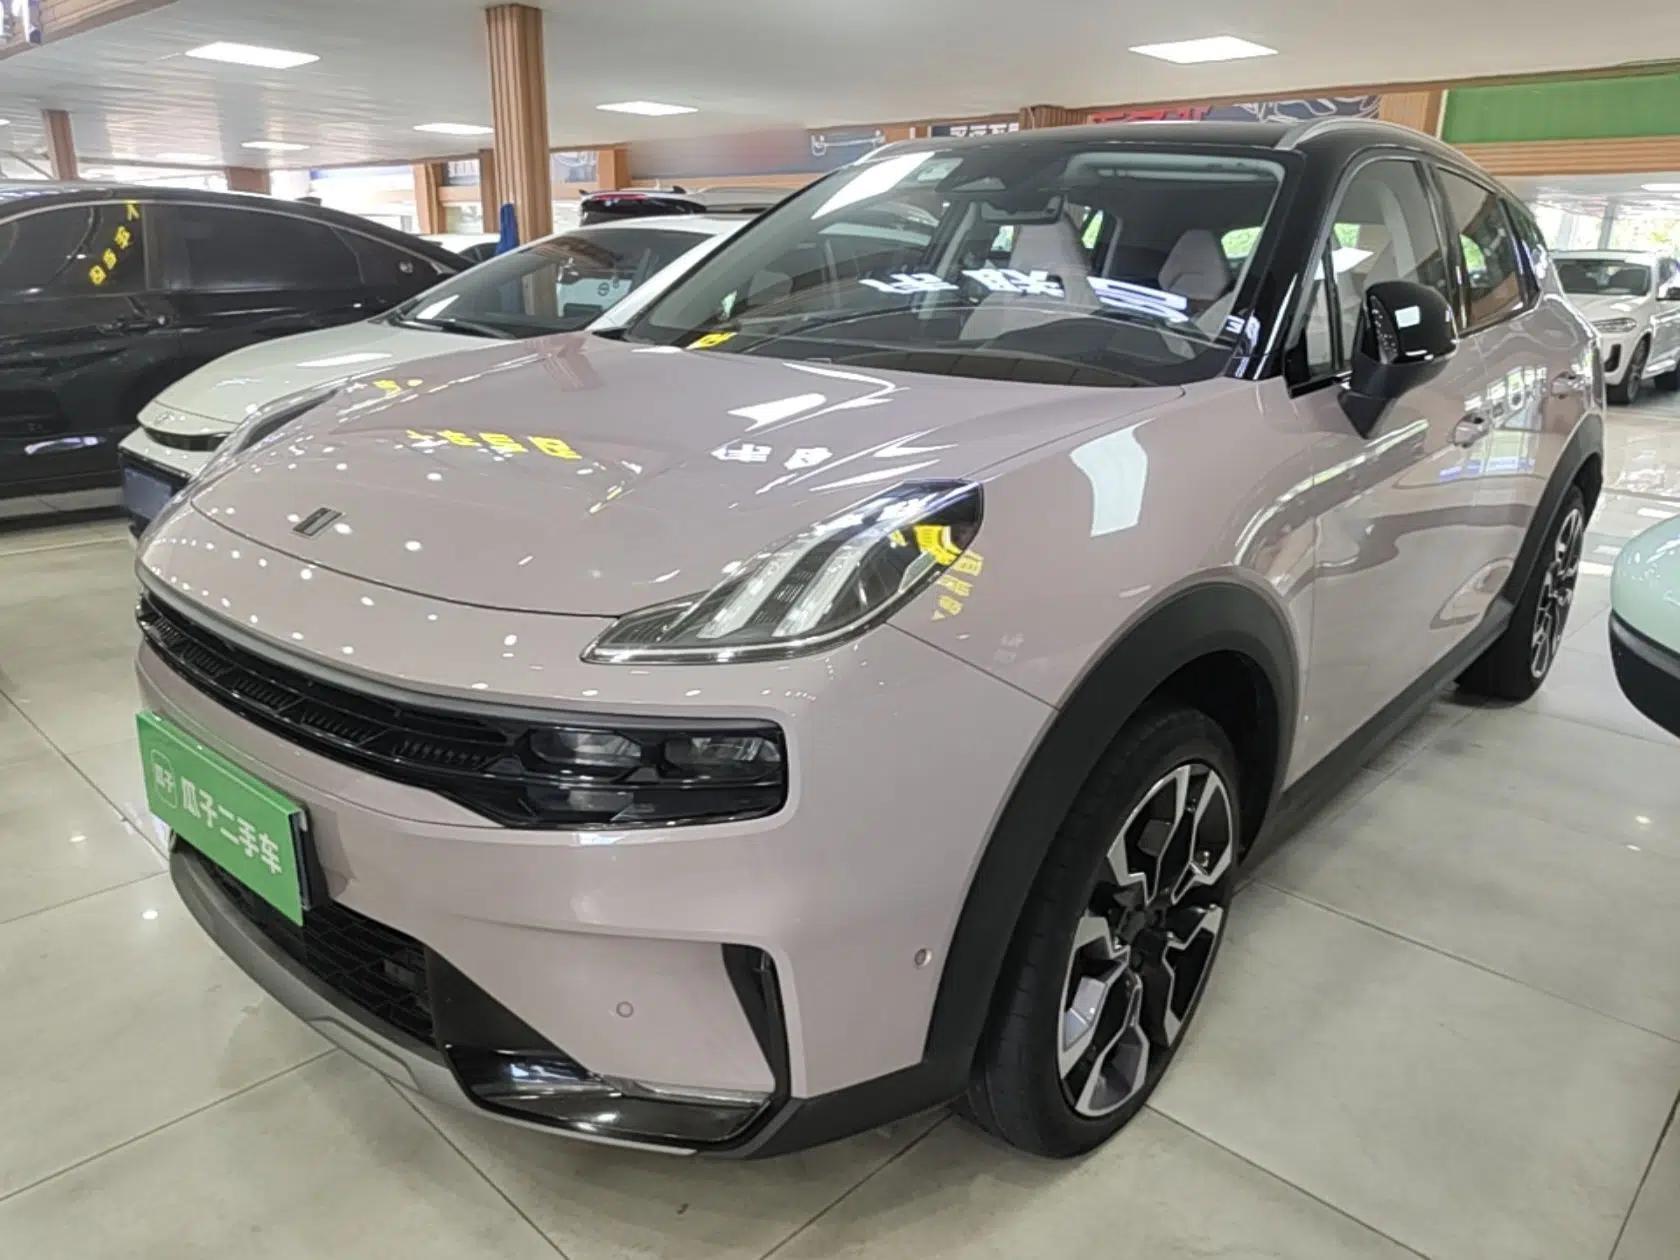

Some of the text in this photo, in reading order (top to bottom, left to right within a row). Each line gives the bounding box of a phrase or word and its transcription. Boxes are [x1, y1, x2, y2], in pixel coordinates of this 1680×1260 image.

[180, 775, 283, 875] 瓜子二手车
